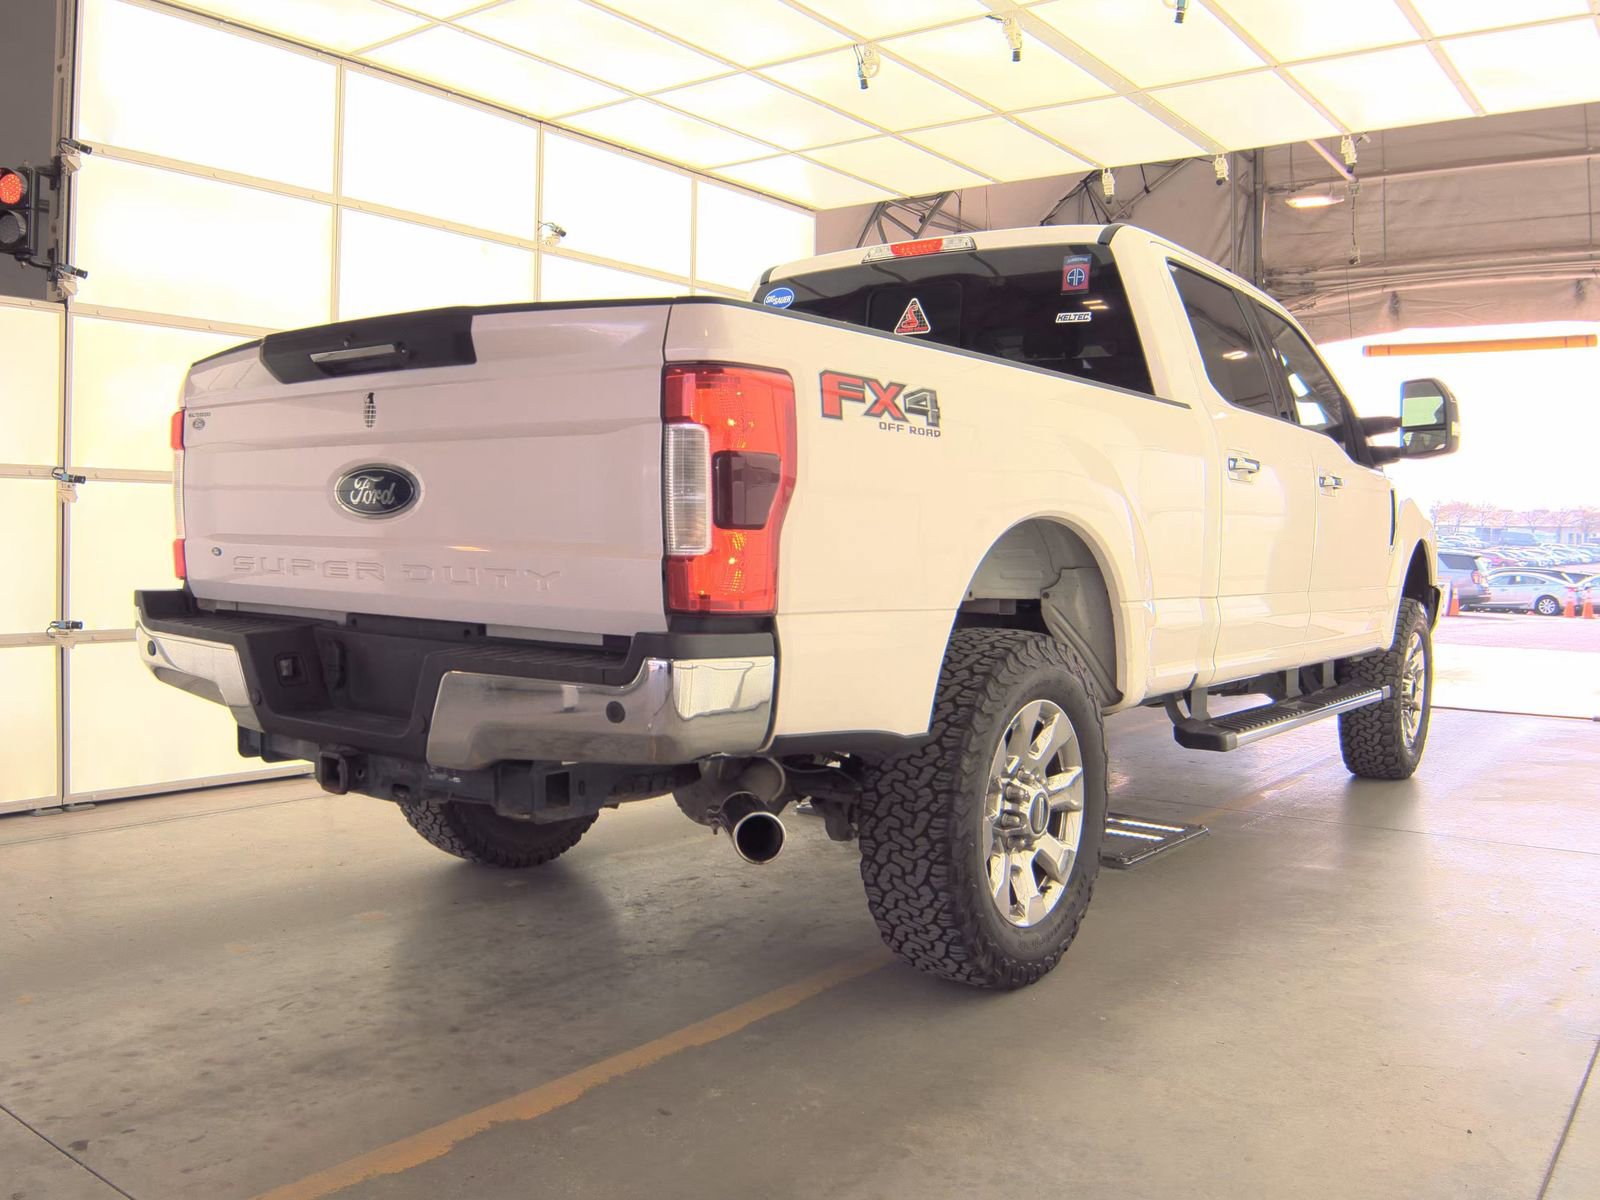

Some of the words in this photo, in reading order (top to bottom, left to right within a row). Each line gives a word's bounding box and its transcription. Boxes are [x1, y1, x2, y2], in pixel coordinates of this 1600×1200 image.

[1056, 312, 1091, 322] KELTEC
[818, 369, 941, 428] FX4
[879, 421, 905, 433] OFF
[909, 425, 942, 439] ROAD
[349, 475, 396, 505] Ford
[232, 555, 386, 582] SUPER
[401, 563, 562, 592] DUTY
